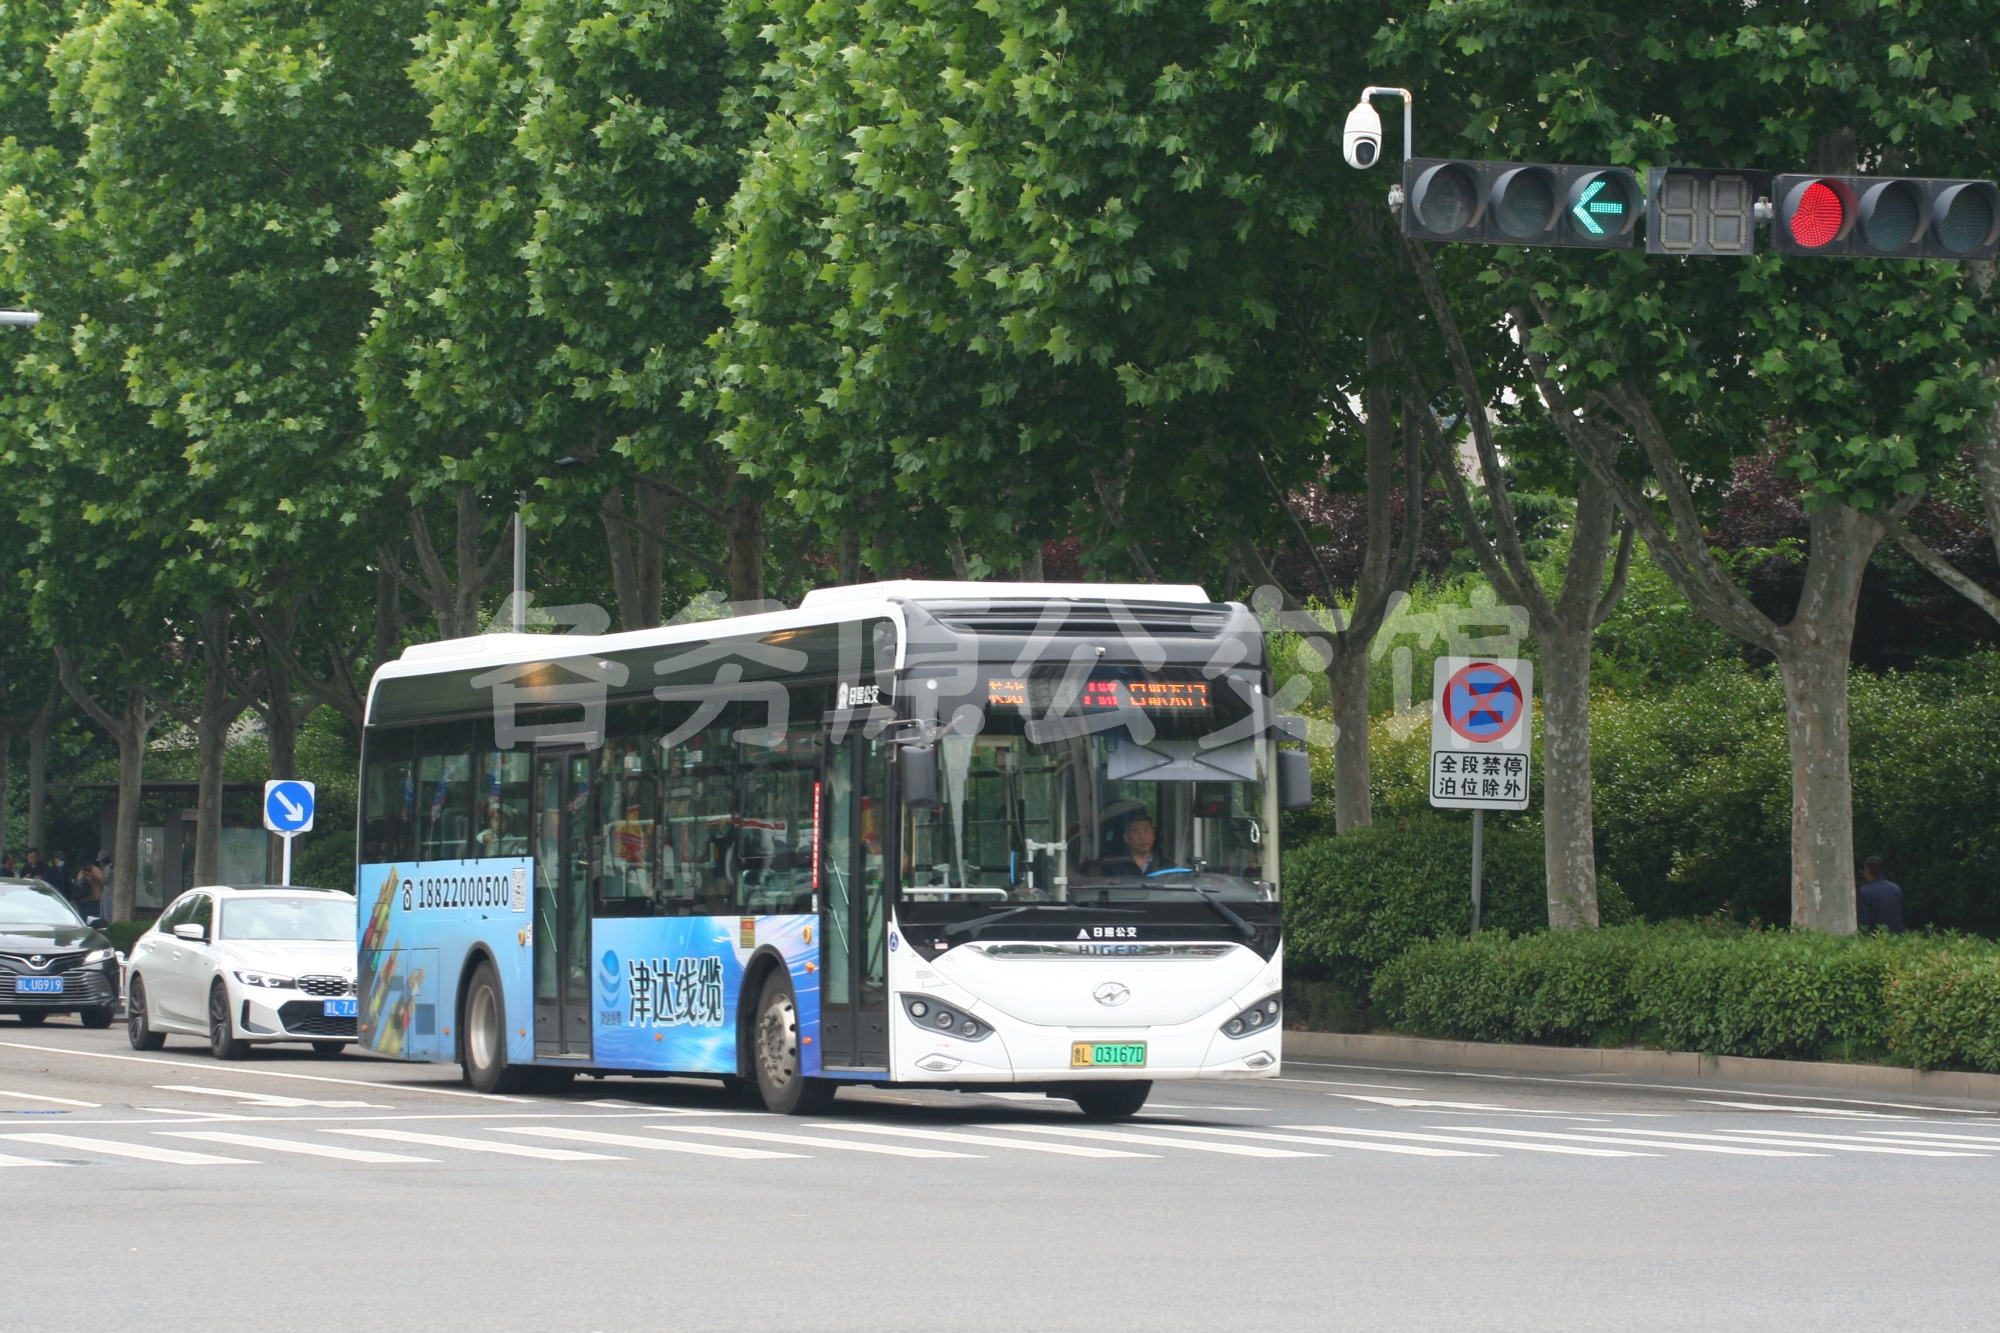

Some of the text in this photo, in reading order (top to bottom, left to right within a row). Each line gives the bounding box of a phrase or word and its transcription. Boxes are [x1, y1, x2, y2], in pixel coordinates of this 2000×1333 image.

[849, 684, 880, 705] 日照公交
[1440, 755, 1523, 777] 全段禁停
[1439, 776, 1521, 798] 泊位除外
[418, 875, 509, 909] 18822000500
[1093, 926, 1138, 938] 日照公交
[1079, 944, 1139, 957] HIGER
[628, 956, 723, 1027] 津达线缆
